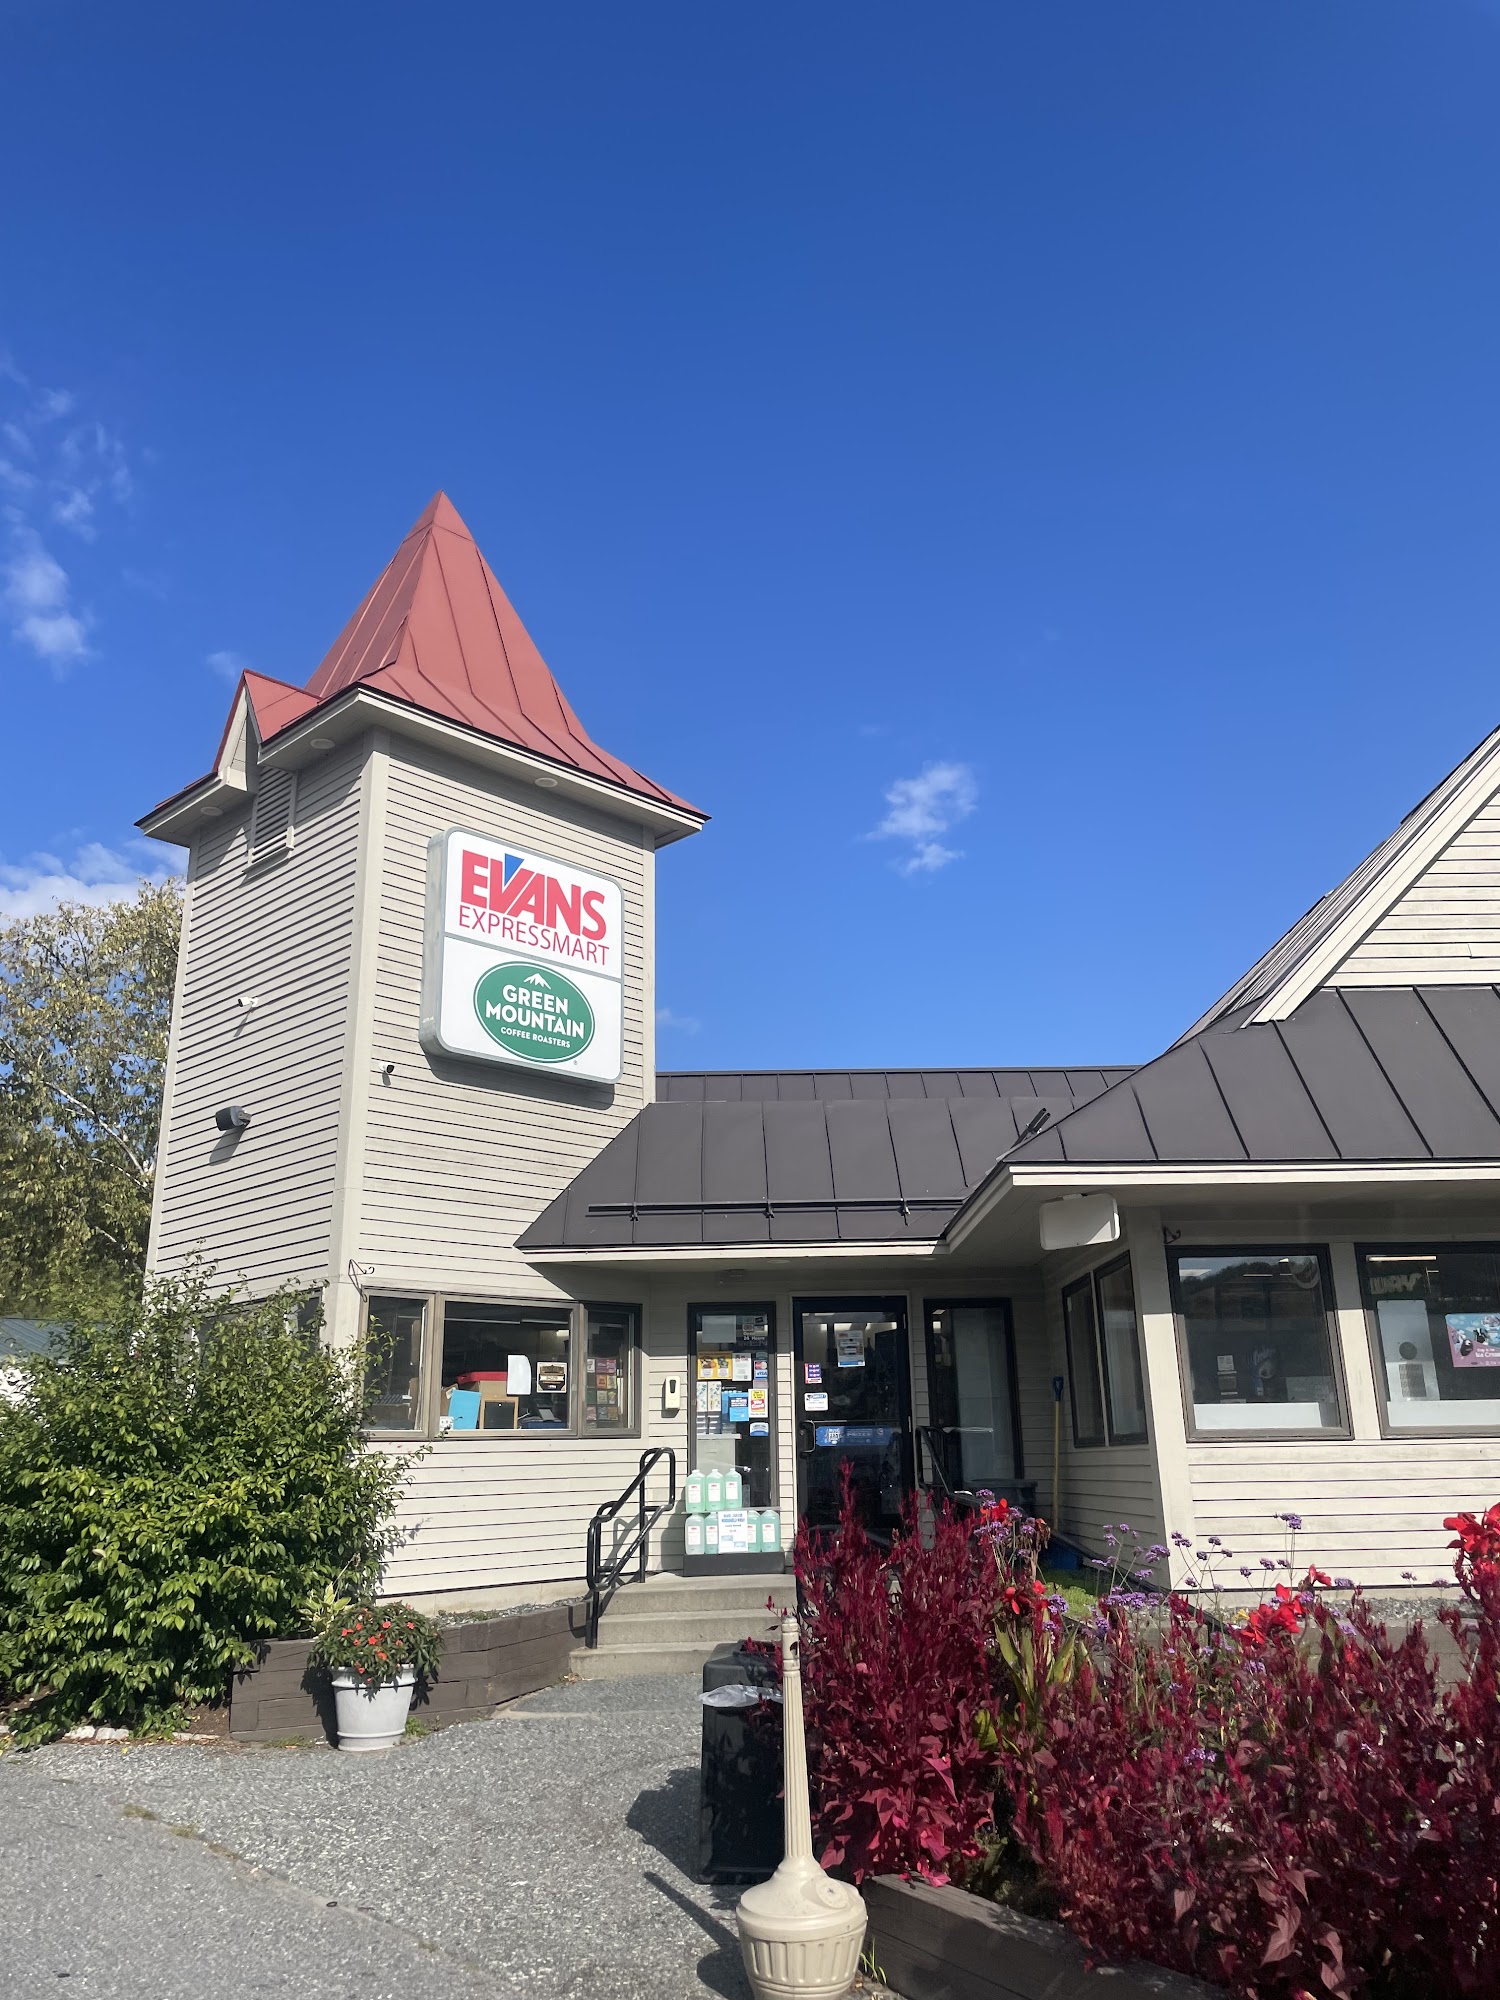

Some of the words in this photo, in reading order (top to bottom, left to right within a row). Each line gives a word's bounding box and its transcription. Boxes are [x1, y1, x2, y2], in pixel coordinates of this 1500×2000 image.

[461, 849, 607, 941] EVANS
[459, 904, 609, 966] EXPRESSMART
[485, 1000, 585, 1039] MOUNTAIN
[502, 984, 568, 1016] GREEN
[500, 1026, 531, 1041] COFFEE
[532, 1033, 571, 1048] ROASTERS
